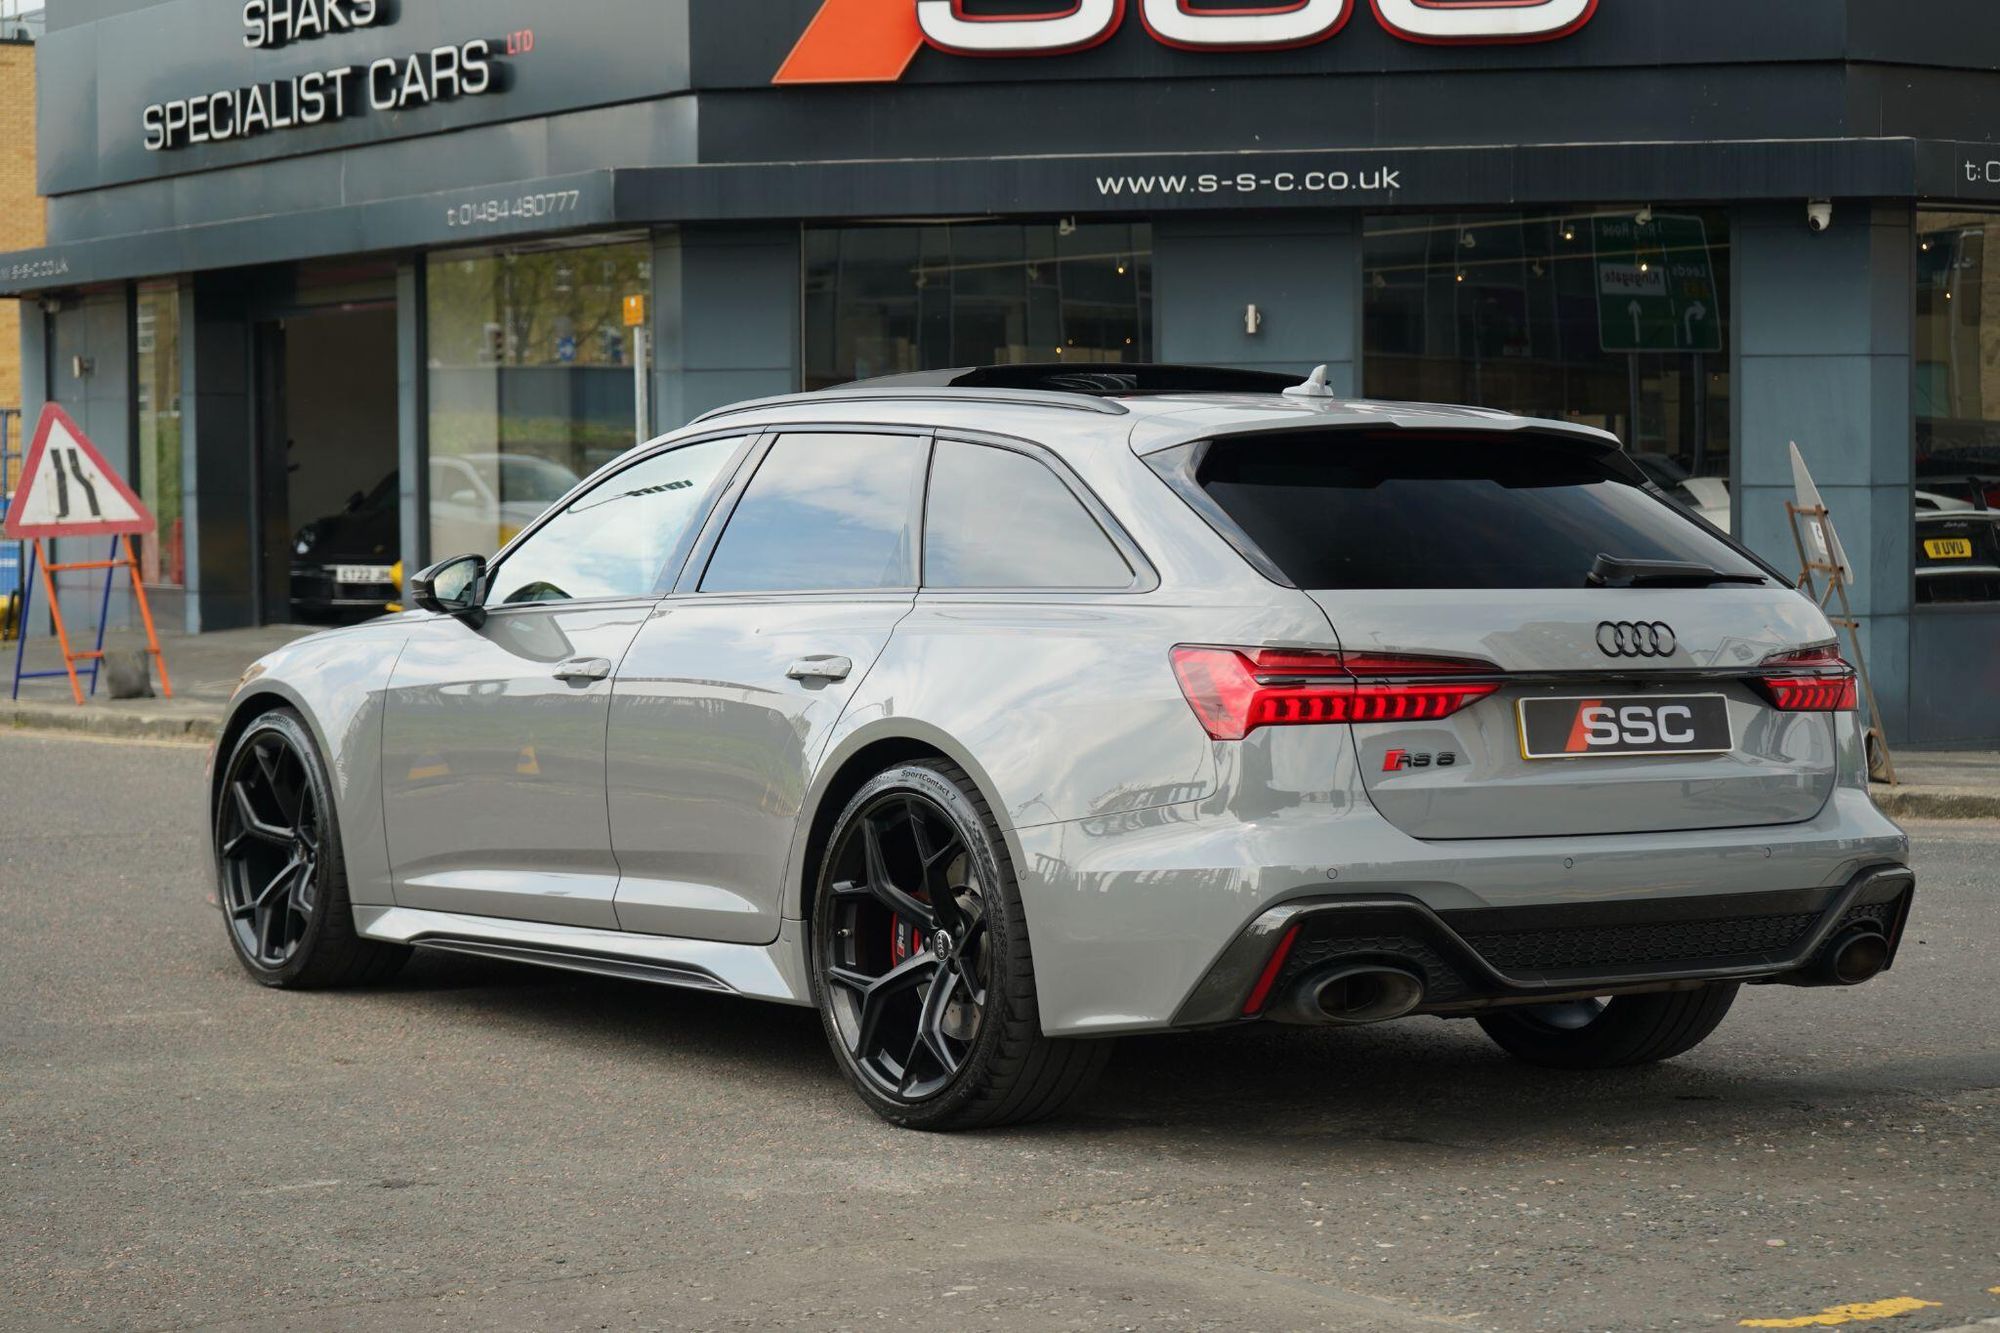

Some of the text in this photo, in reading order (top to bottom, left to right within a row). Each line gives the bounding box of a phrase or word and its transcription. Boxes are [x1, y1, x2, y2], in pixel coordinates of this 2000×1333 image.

[143, 29, 534, 151] SPECIALIST CARS LTD
[1096, 166, 1401, 195] www.s-s-c.co.uk
[1582, 705, 1695, 745] SSC
[900, 769, 950, 797] SportContact
